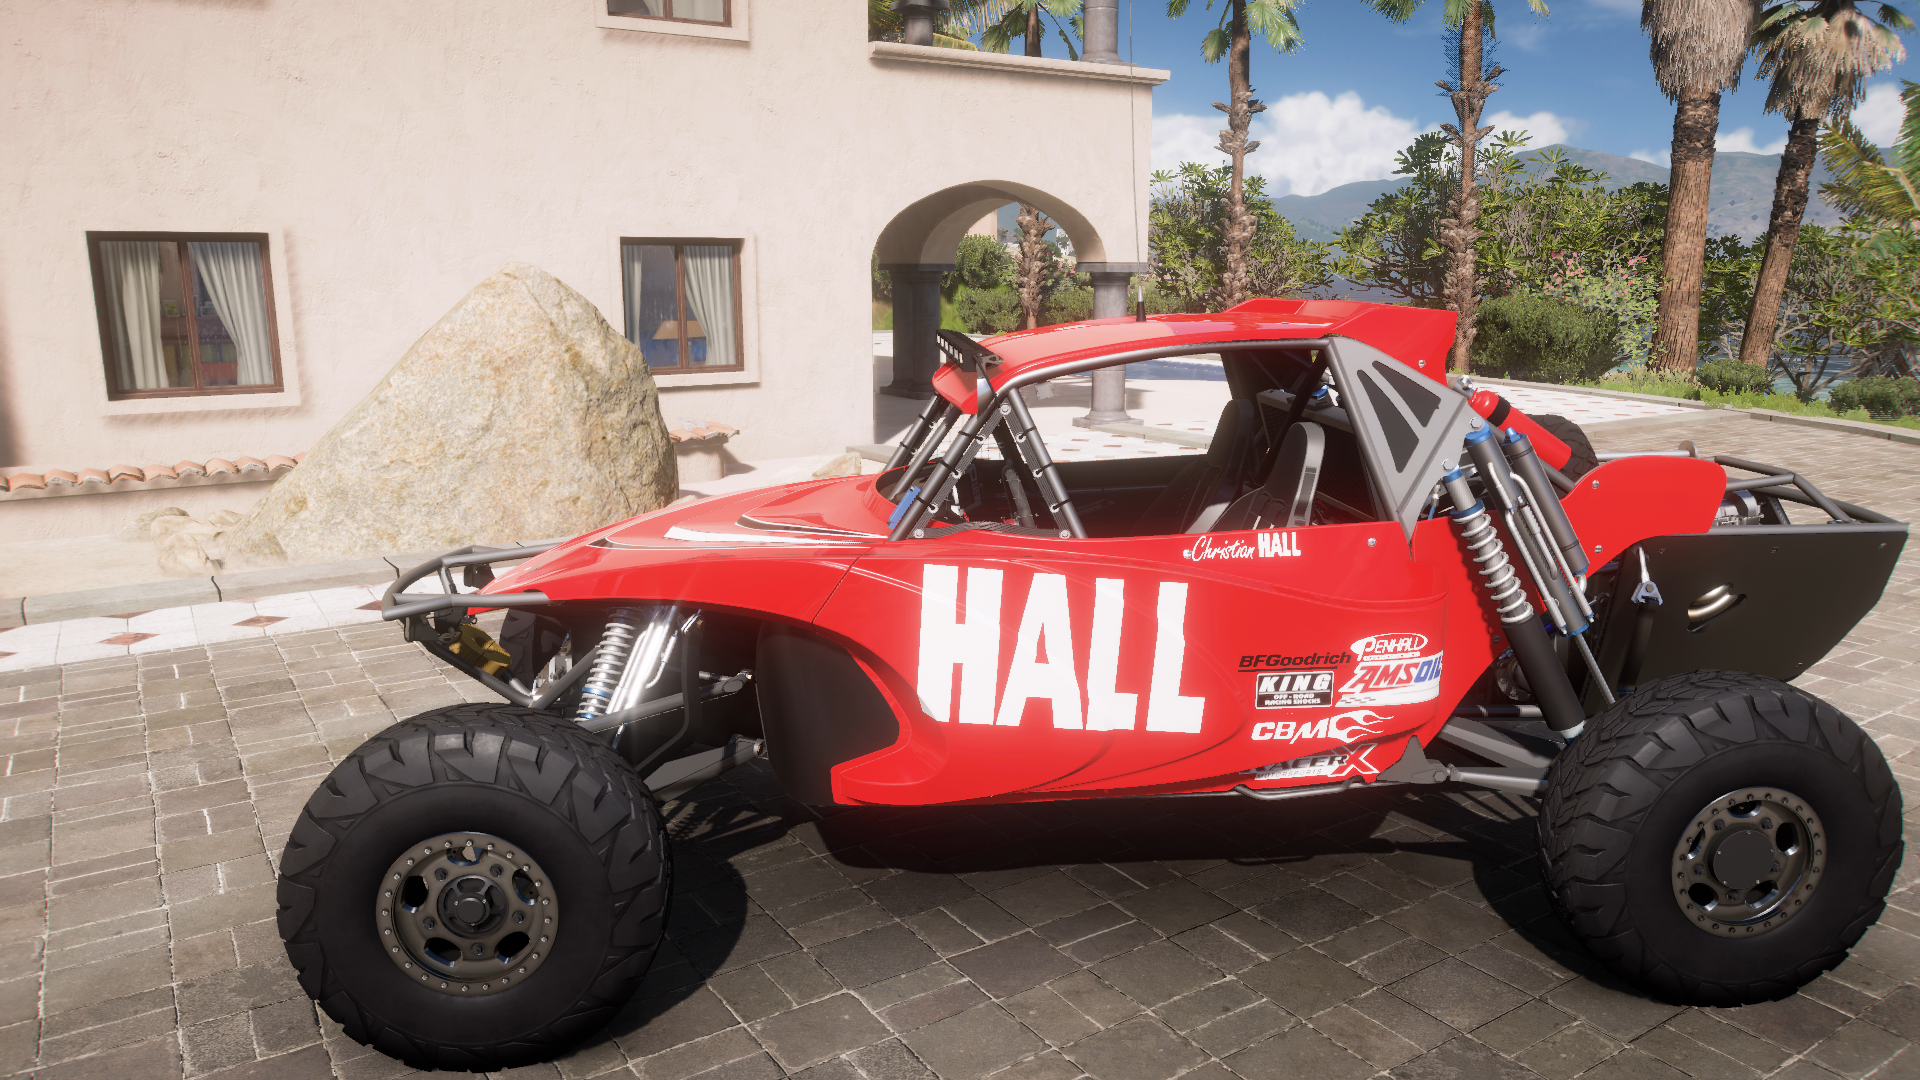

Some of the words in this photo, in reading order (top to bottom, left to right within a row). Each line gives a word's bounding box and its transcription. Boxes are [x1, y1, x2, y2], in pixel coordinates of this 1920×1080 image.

[1192, 534, 1255, 561] Christian
[1257, 532, 1301, 558] HALL
[917, 564, 1206, 733] HALL
[1239, 652, 1352, 668] BFGoodrich
[1356, 636, 1419, 661] PENHALL
[1259, 674, 1332, 692] KING
[1347, 656, 1443, 694] AMSOIL
[1255, 769, 1323, 779] MOTORSPORTS
